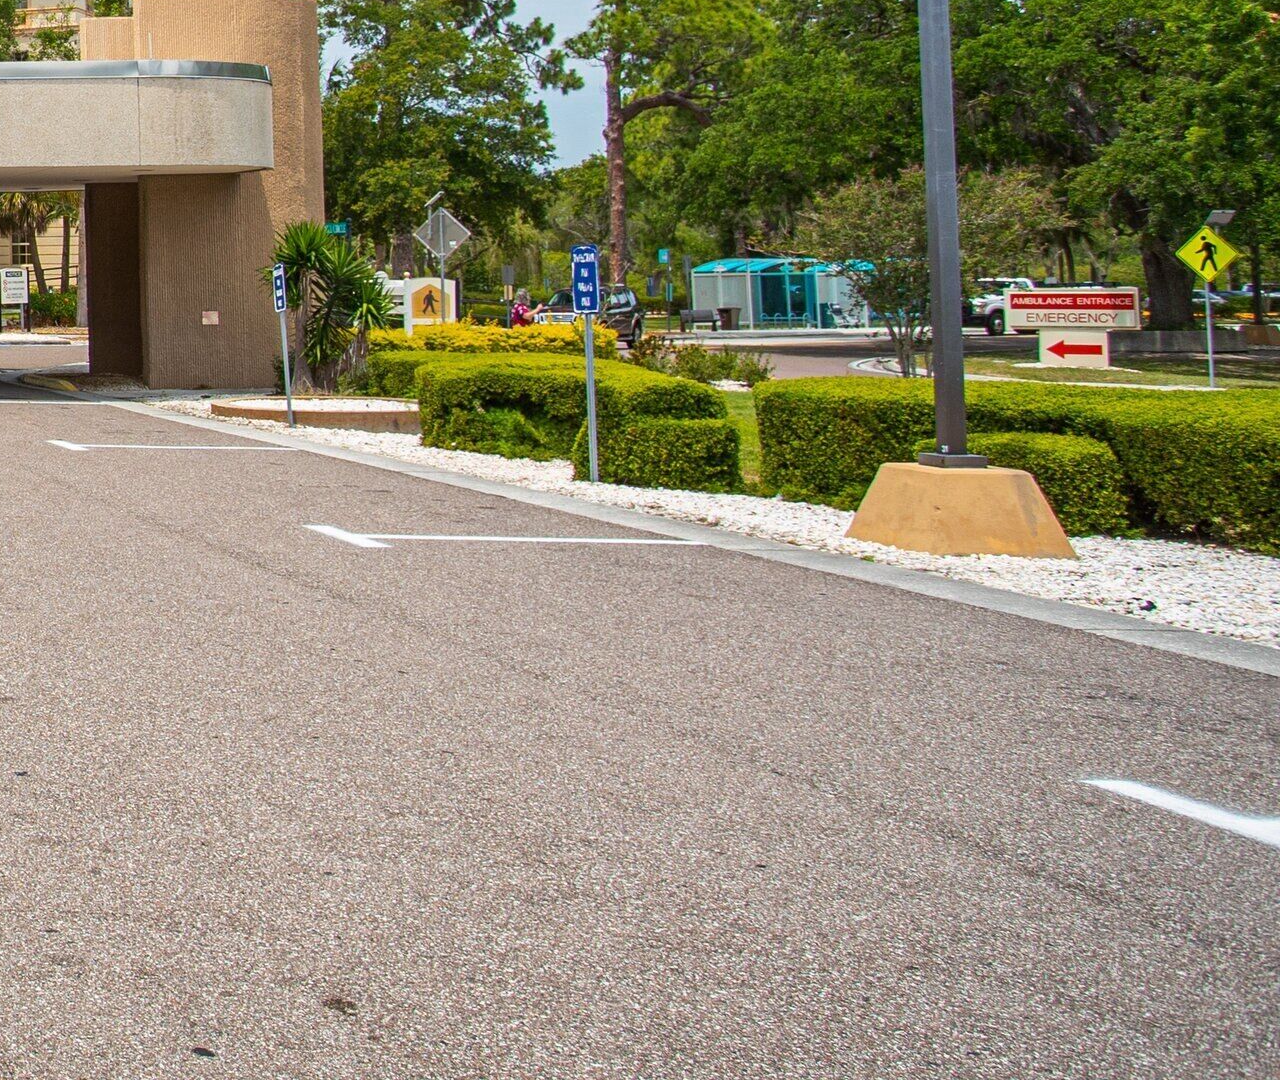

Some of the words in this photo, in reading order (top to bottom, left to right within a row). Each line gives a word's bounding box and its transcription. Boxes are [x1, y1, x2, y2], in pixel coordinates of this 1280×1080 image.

[1012, 297, 1073, 305] AMBULANCE
[1076, 297, 1133, 305] ENTRANCE
[1026, 312, 1118, 323] EMERGENCY
